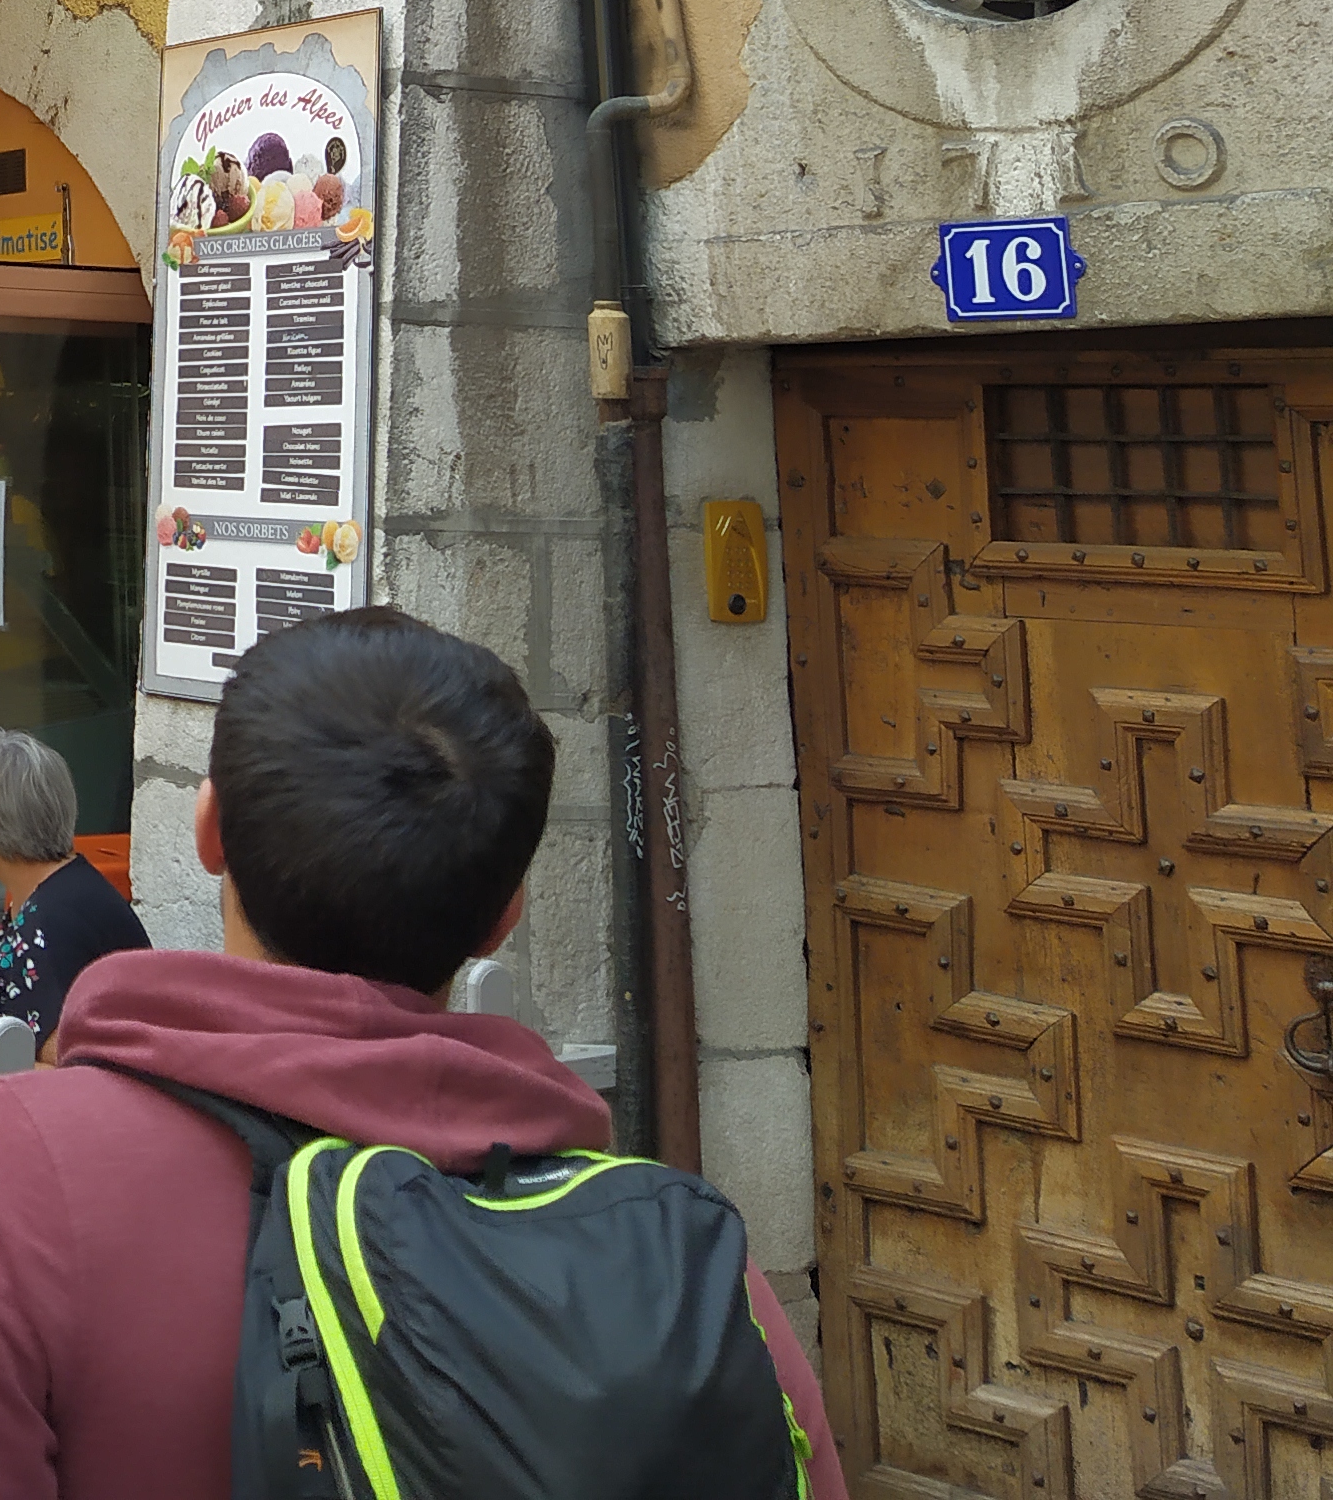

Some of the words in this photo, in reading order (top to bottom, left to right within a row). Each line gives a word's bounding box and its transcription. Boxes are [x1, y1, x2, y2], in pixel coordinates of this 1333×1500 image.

[195, 96, 254, 151] Glacier
[259, 83, 288, 108] des
[292, 87, 346, 131] Alpes
[199, 240, 222, 257] NOS
[223, 236, 268, 254] CRÈMES
[270, 231, 323, 252] GLACÉES
[964, 236, 1047, 303] 16
[213, 521, 238, 537] NOS
[238, 522, 289, 540] SORBETS
